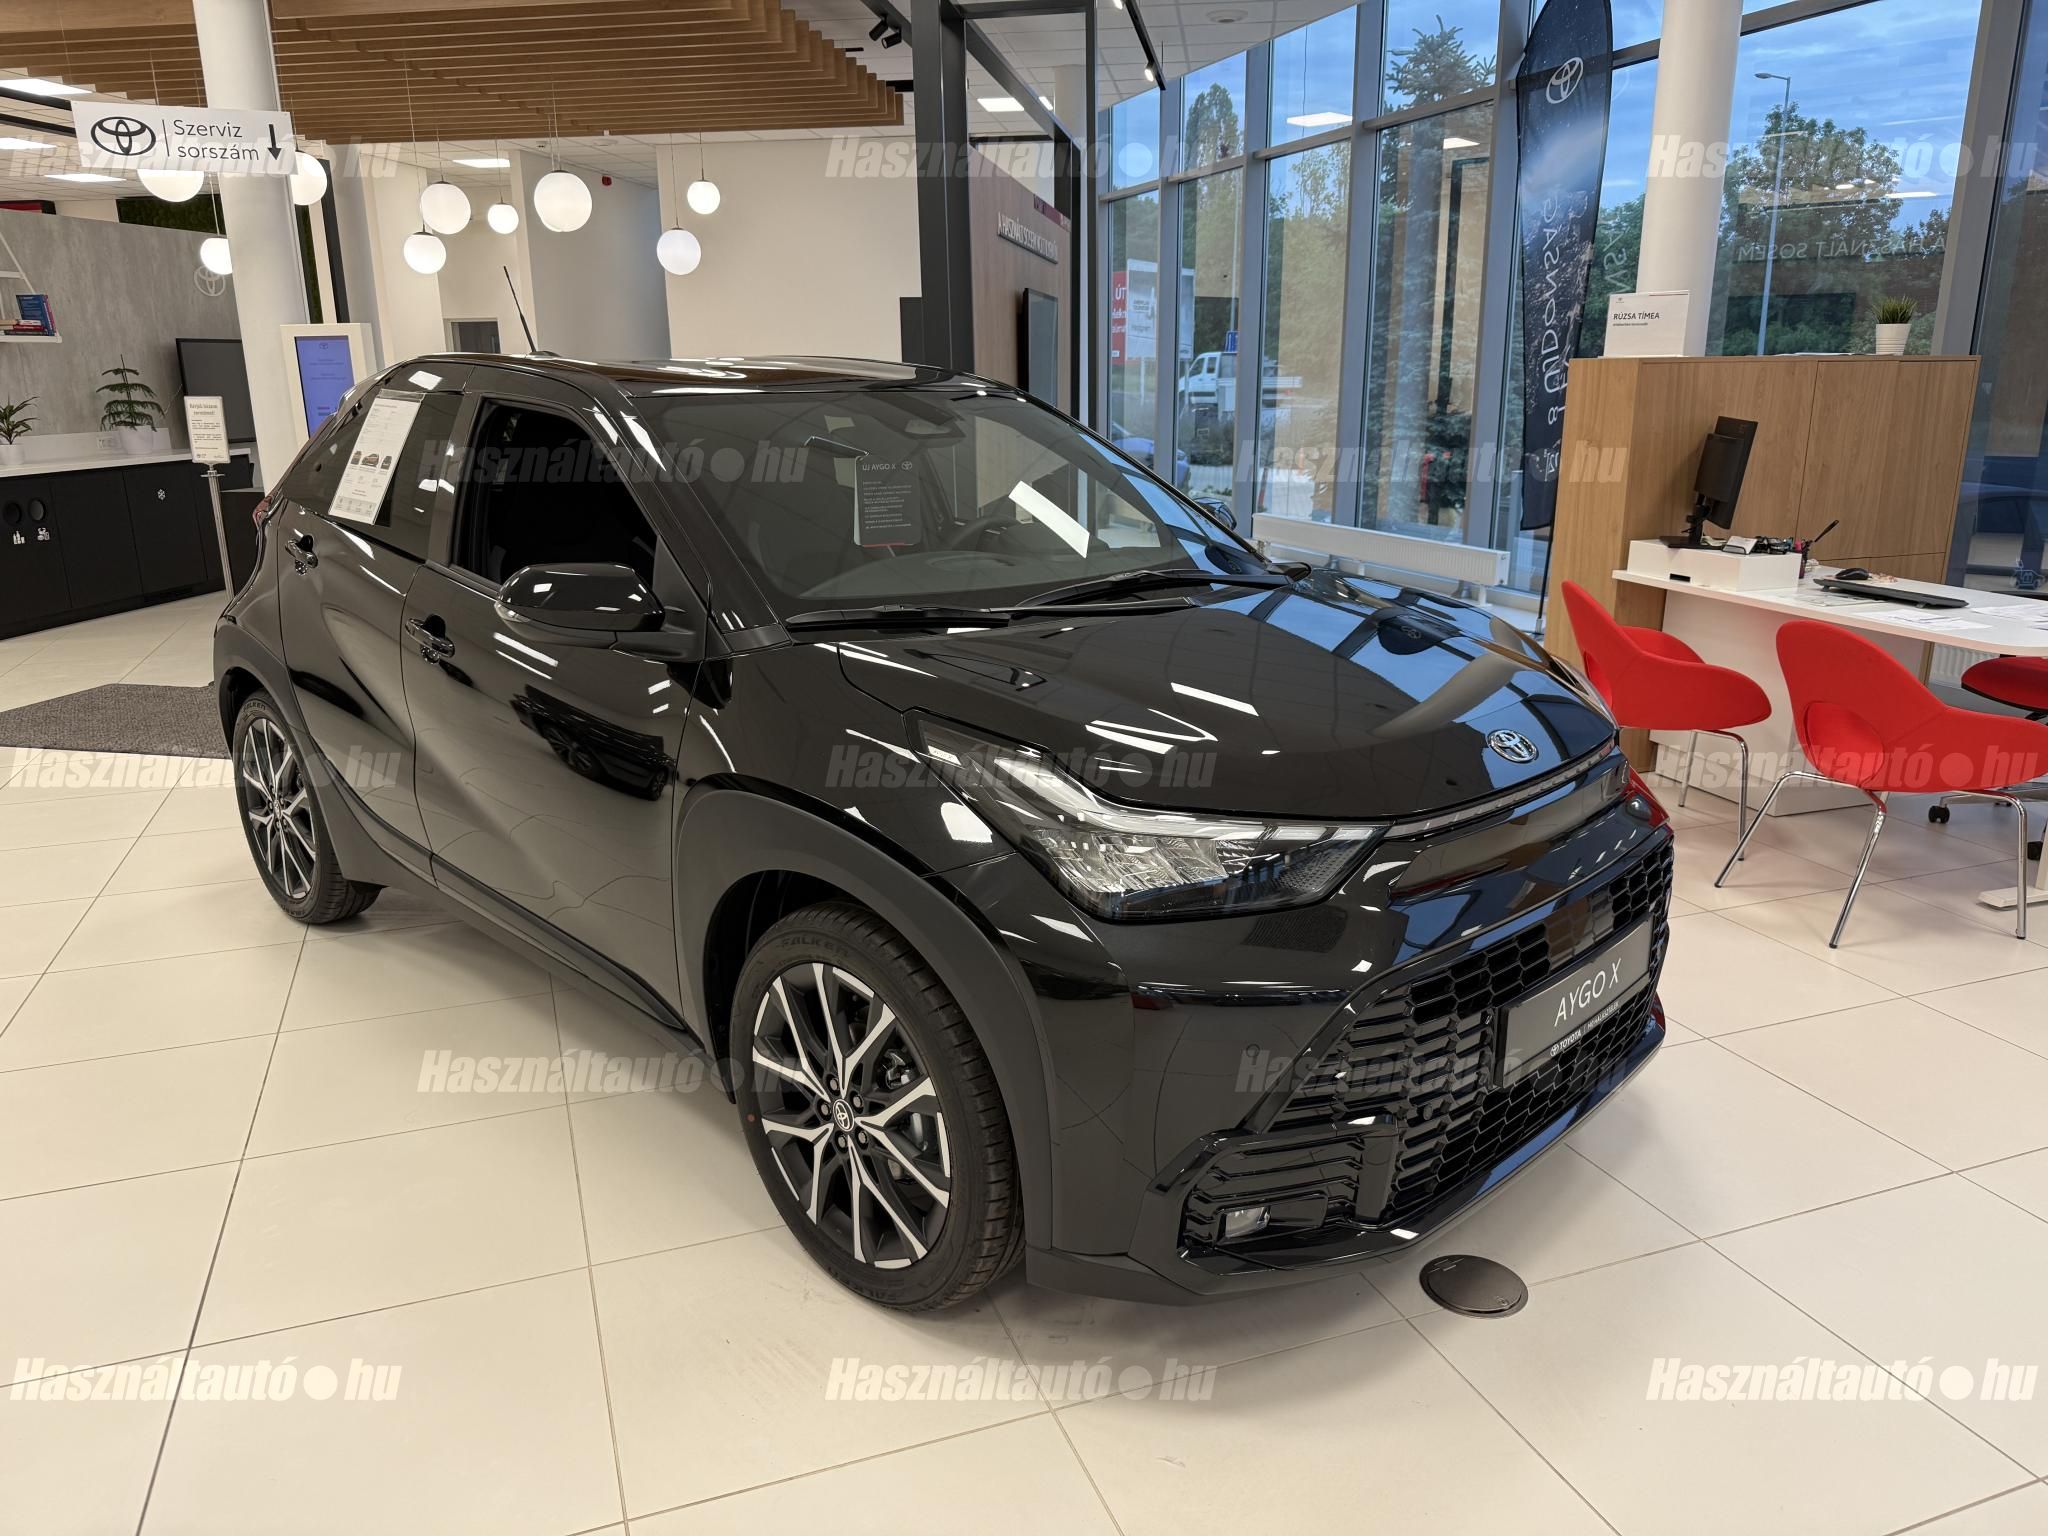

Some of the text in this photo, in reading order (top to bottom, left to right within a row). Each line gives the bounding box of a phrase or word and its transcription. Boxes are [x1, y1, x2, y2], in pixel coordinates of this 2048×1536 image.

[173, 119, 243, 138] Szerviz
[177, 143, 259, 161] sorszám
[1637, 310, 1660, 320] TÍMEA
[871, 463, 890, 471] AYGO
[1554, 970, 1606, 1027] AYGO
[1609, 957, 1622, 989] X
[1559, 1029, 1582, 1050] TOYOTA
